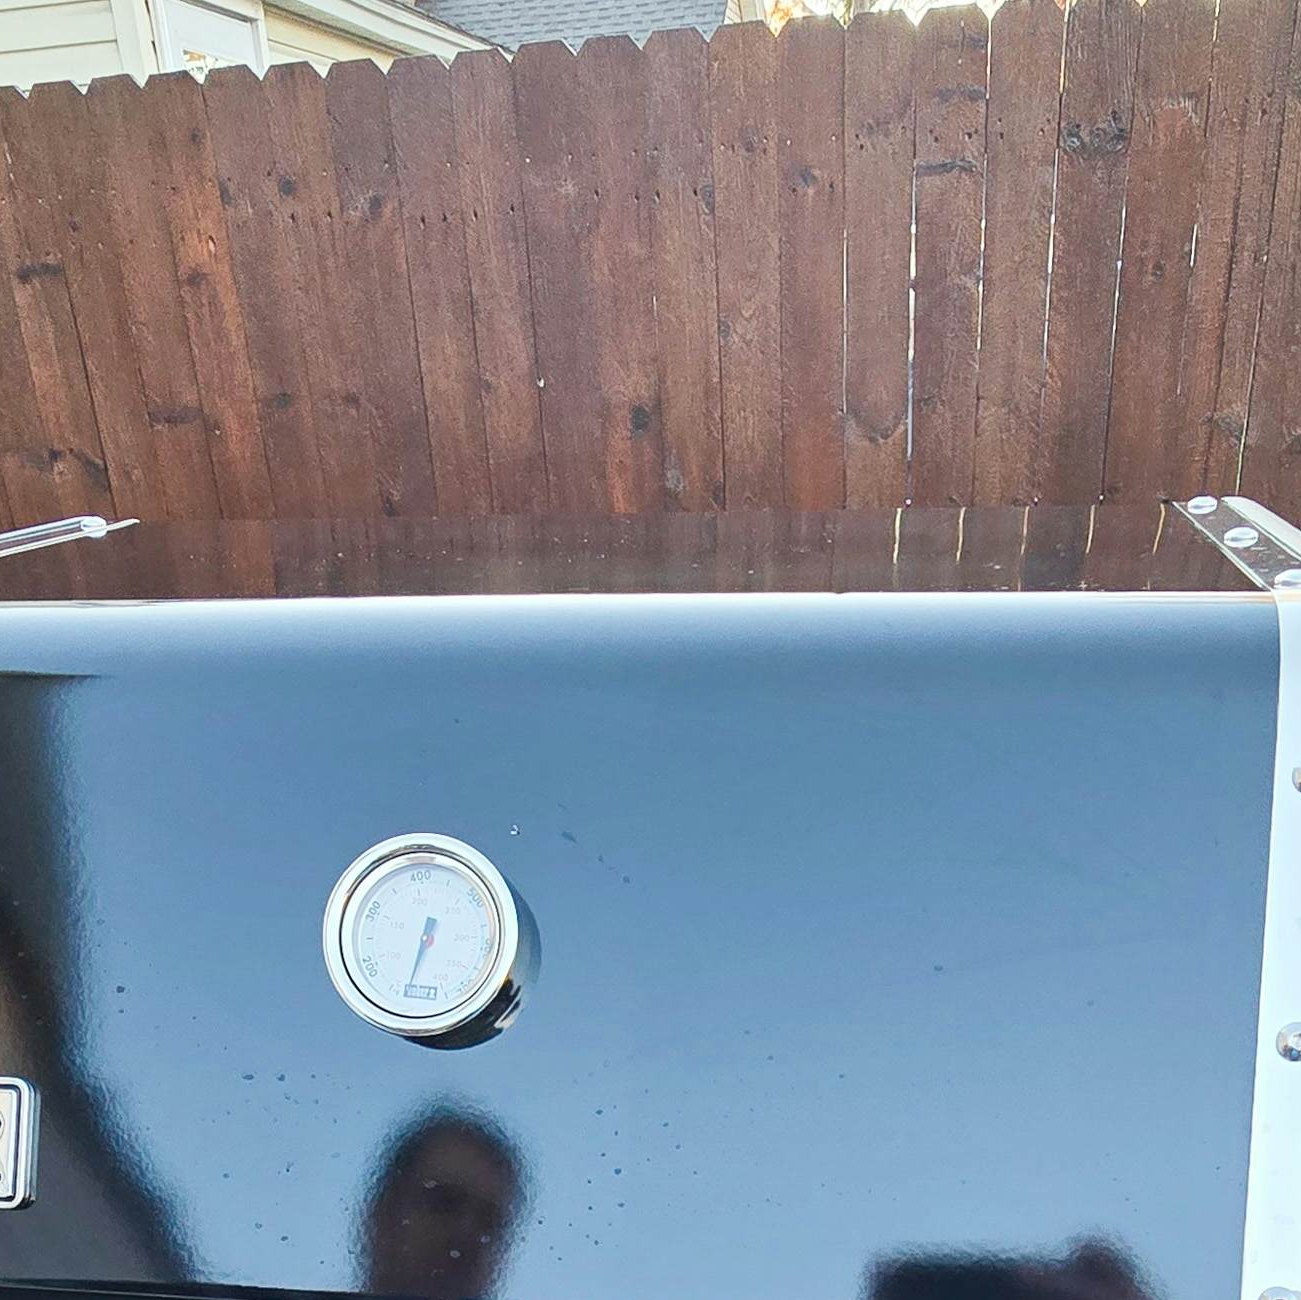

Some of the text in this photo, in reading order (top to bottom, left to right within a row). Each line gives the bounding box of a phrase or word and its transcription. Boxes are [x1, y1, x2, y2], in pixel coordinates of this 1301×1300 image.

[410, 870, 431, 882] 400
[365, 900, 381, 922] 300
[362, 955, 379, 979] 200
